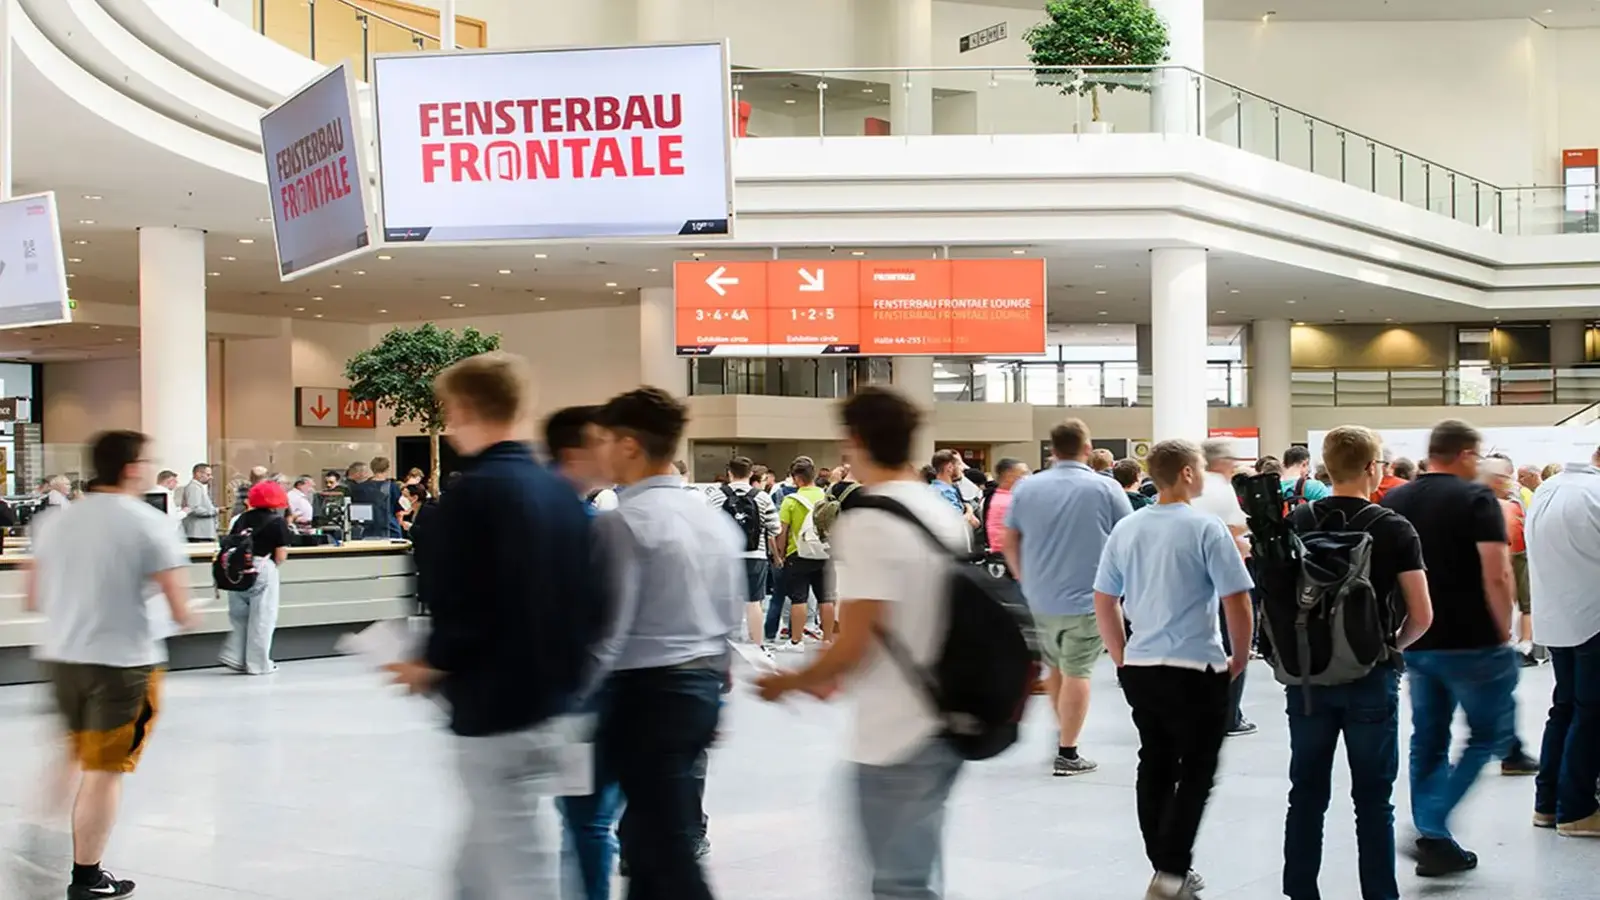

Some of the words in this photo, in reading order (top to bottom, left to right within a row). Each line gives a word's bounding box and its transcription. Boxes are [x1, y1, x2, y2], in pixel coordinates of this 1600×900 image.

[418, 93, 683, 137] FENSTERBAU
[275, 116, 345, 182] FENSTERBAU
[421, 135, 685, 183] FRONTALE
[280, 155, 352, 222] FRONTALE
[695, 308, 704, 321] 3
[713, 308, 722, 321] 4
[731, 308, 749, 321] 4A
[791, 308, 798, 321] 1
[808, 308, 817, 321] 2
[826, 308, 835, 320] 5
[873, 299, 937, 309] FENSTERBAU
[938, 299, 988, 309] FRONTALE
[990, 299, 1031, 309] LOUNGE
[343, 399, 371, 420] 4A
